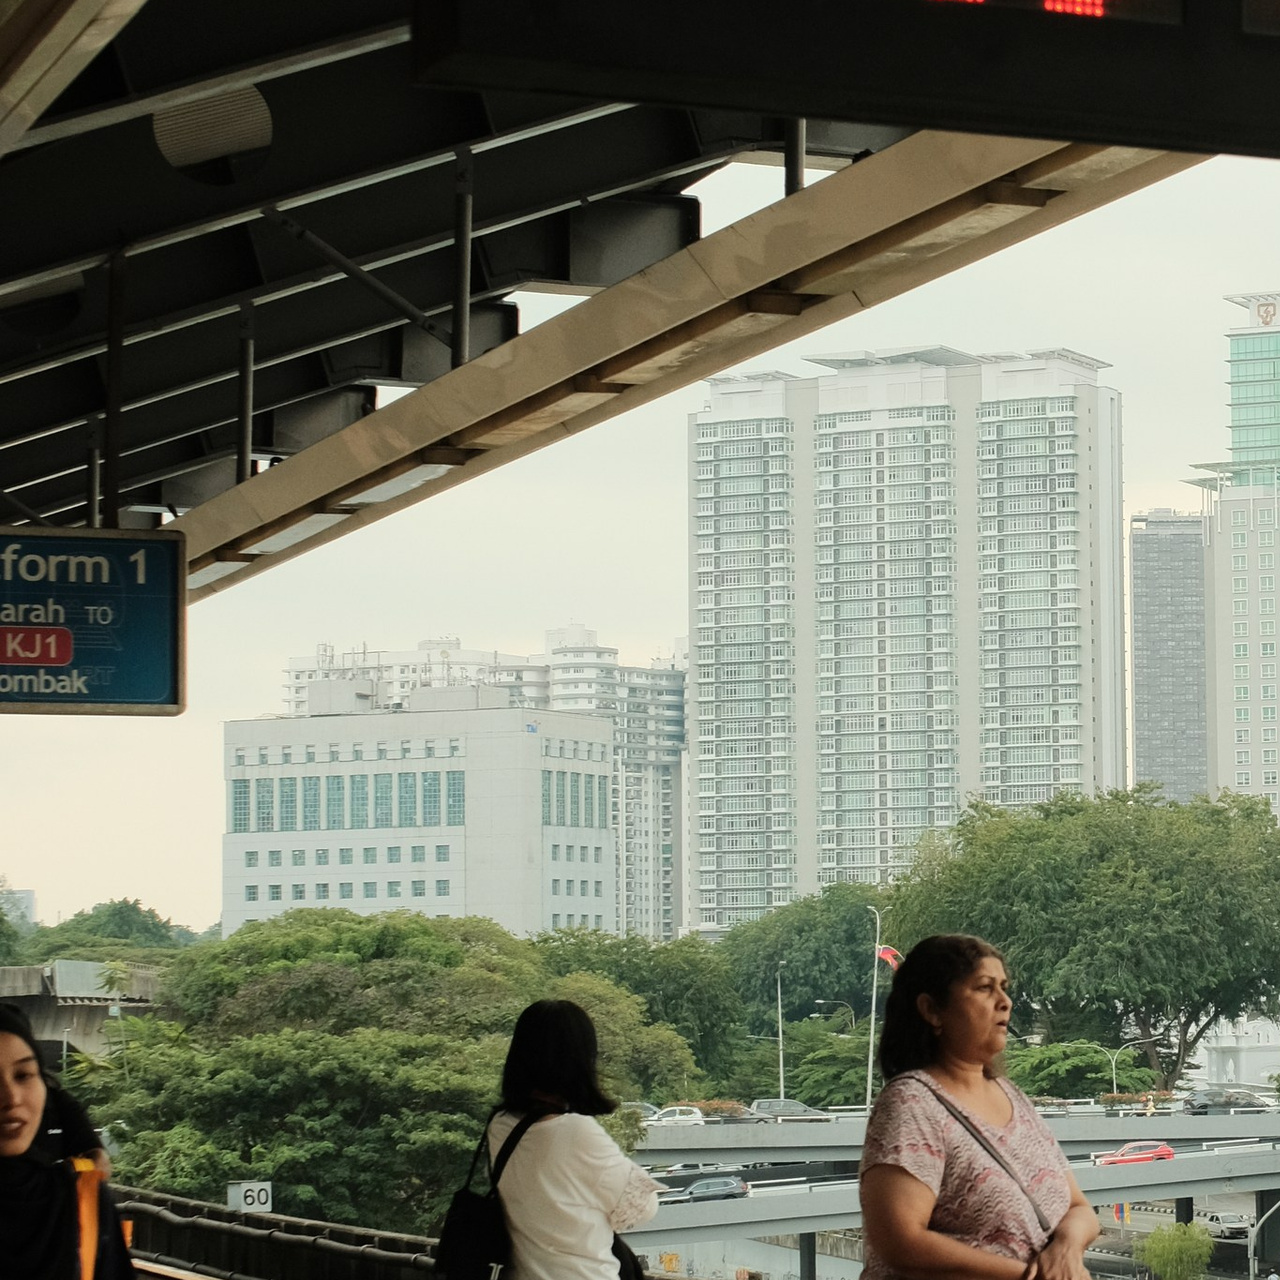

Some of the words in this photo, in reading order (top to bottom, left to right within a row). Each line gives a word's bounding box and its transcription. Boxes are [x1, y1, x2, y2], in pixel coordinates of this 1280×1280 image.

[0, 543, 110, 584] form
[129, 549, 146, 585] 1
[0, 597, 66, 624] arah
[84, 605, 113, 625] TO
[6, 632, 58, 659] KJ1
[0, 668, 89, 694] ombak
[243, 1188, 269, 1206] 60
